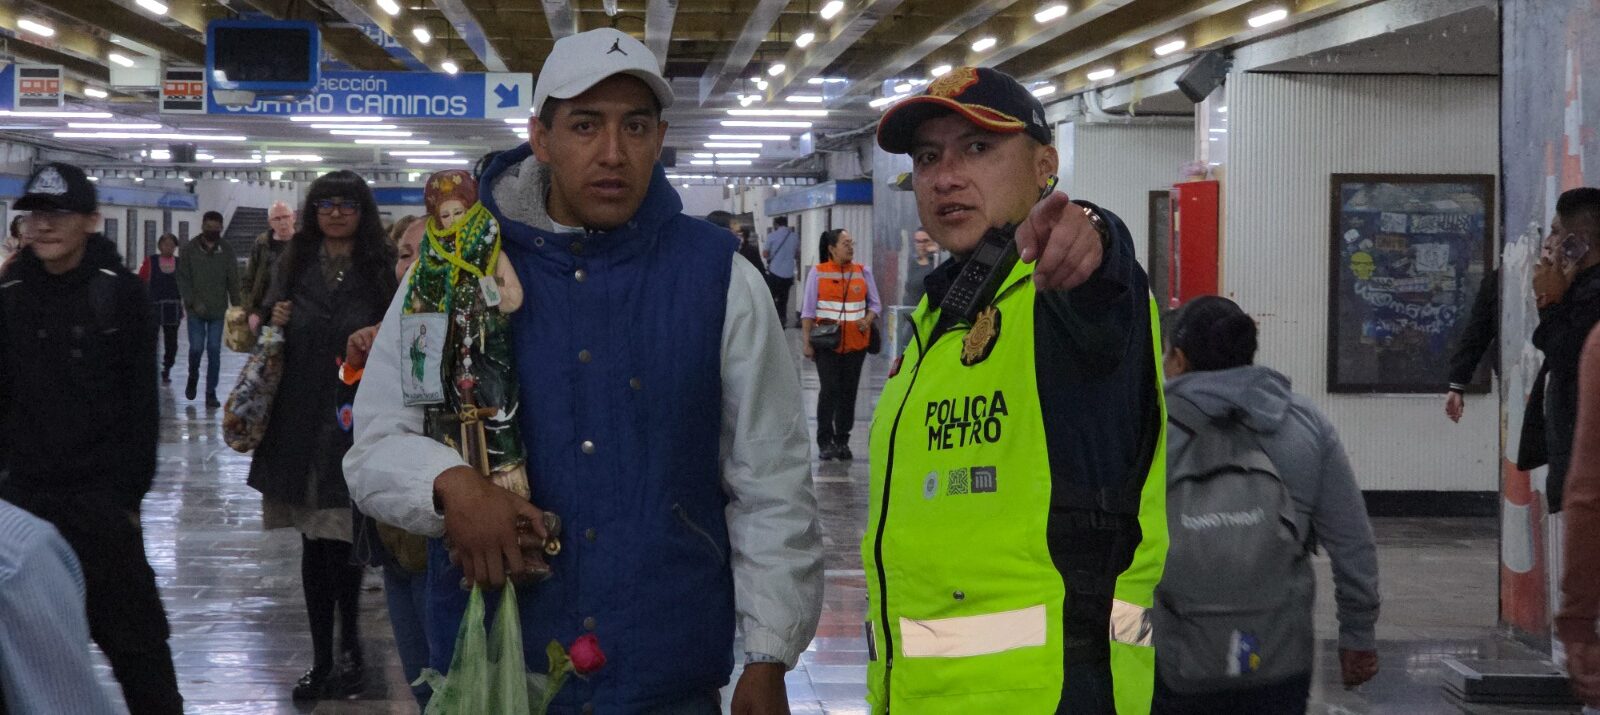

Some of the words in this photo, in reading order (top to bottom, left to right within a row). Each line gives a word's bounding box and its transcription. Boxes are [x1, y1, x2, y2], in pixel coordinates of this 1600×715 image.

[319, 76, 388, 92] RECCIÓN
[346, 95, 468, 116] CAMINOS
[928, 416, 1002, 451] METRO
